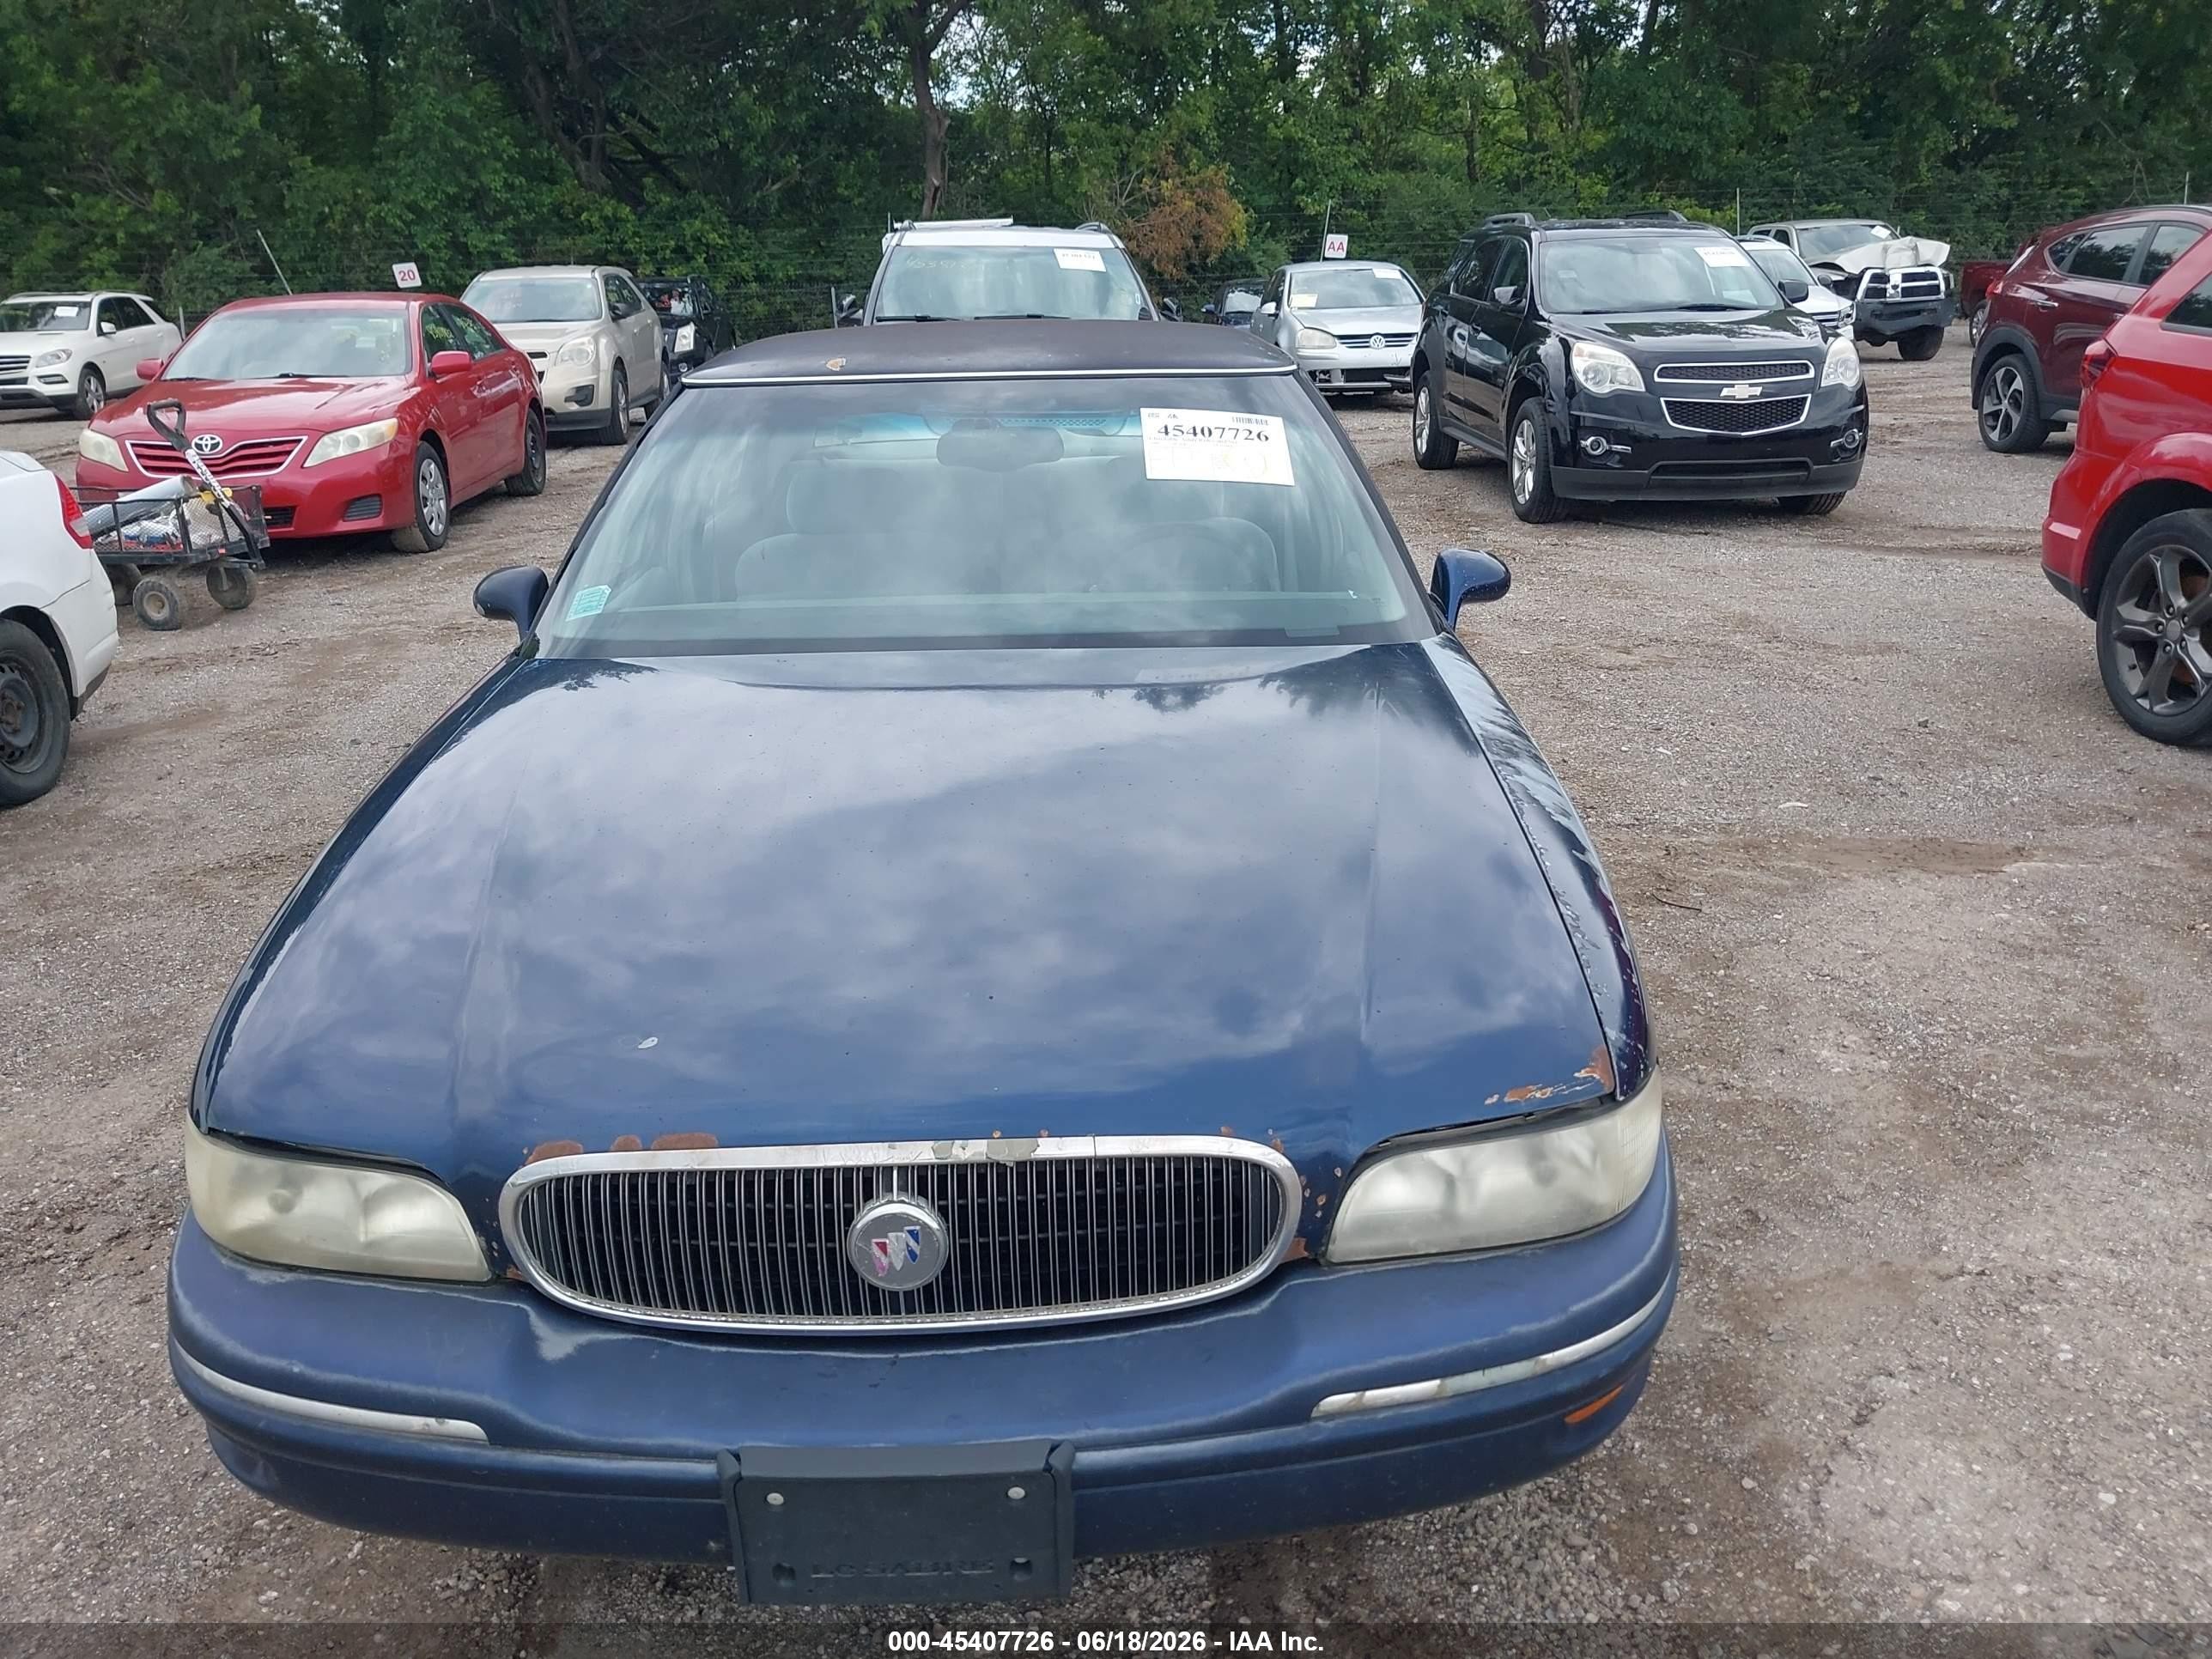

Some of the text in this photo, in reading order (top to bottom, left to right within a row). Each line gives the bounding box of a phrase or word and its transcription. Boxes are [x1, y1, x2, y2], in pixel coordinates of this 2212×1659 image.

[1327, 240, 1346, 252] AA
[398, 269, 416, 282] 20
[1158, 423, 1270, 443] 45407726
